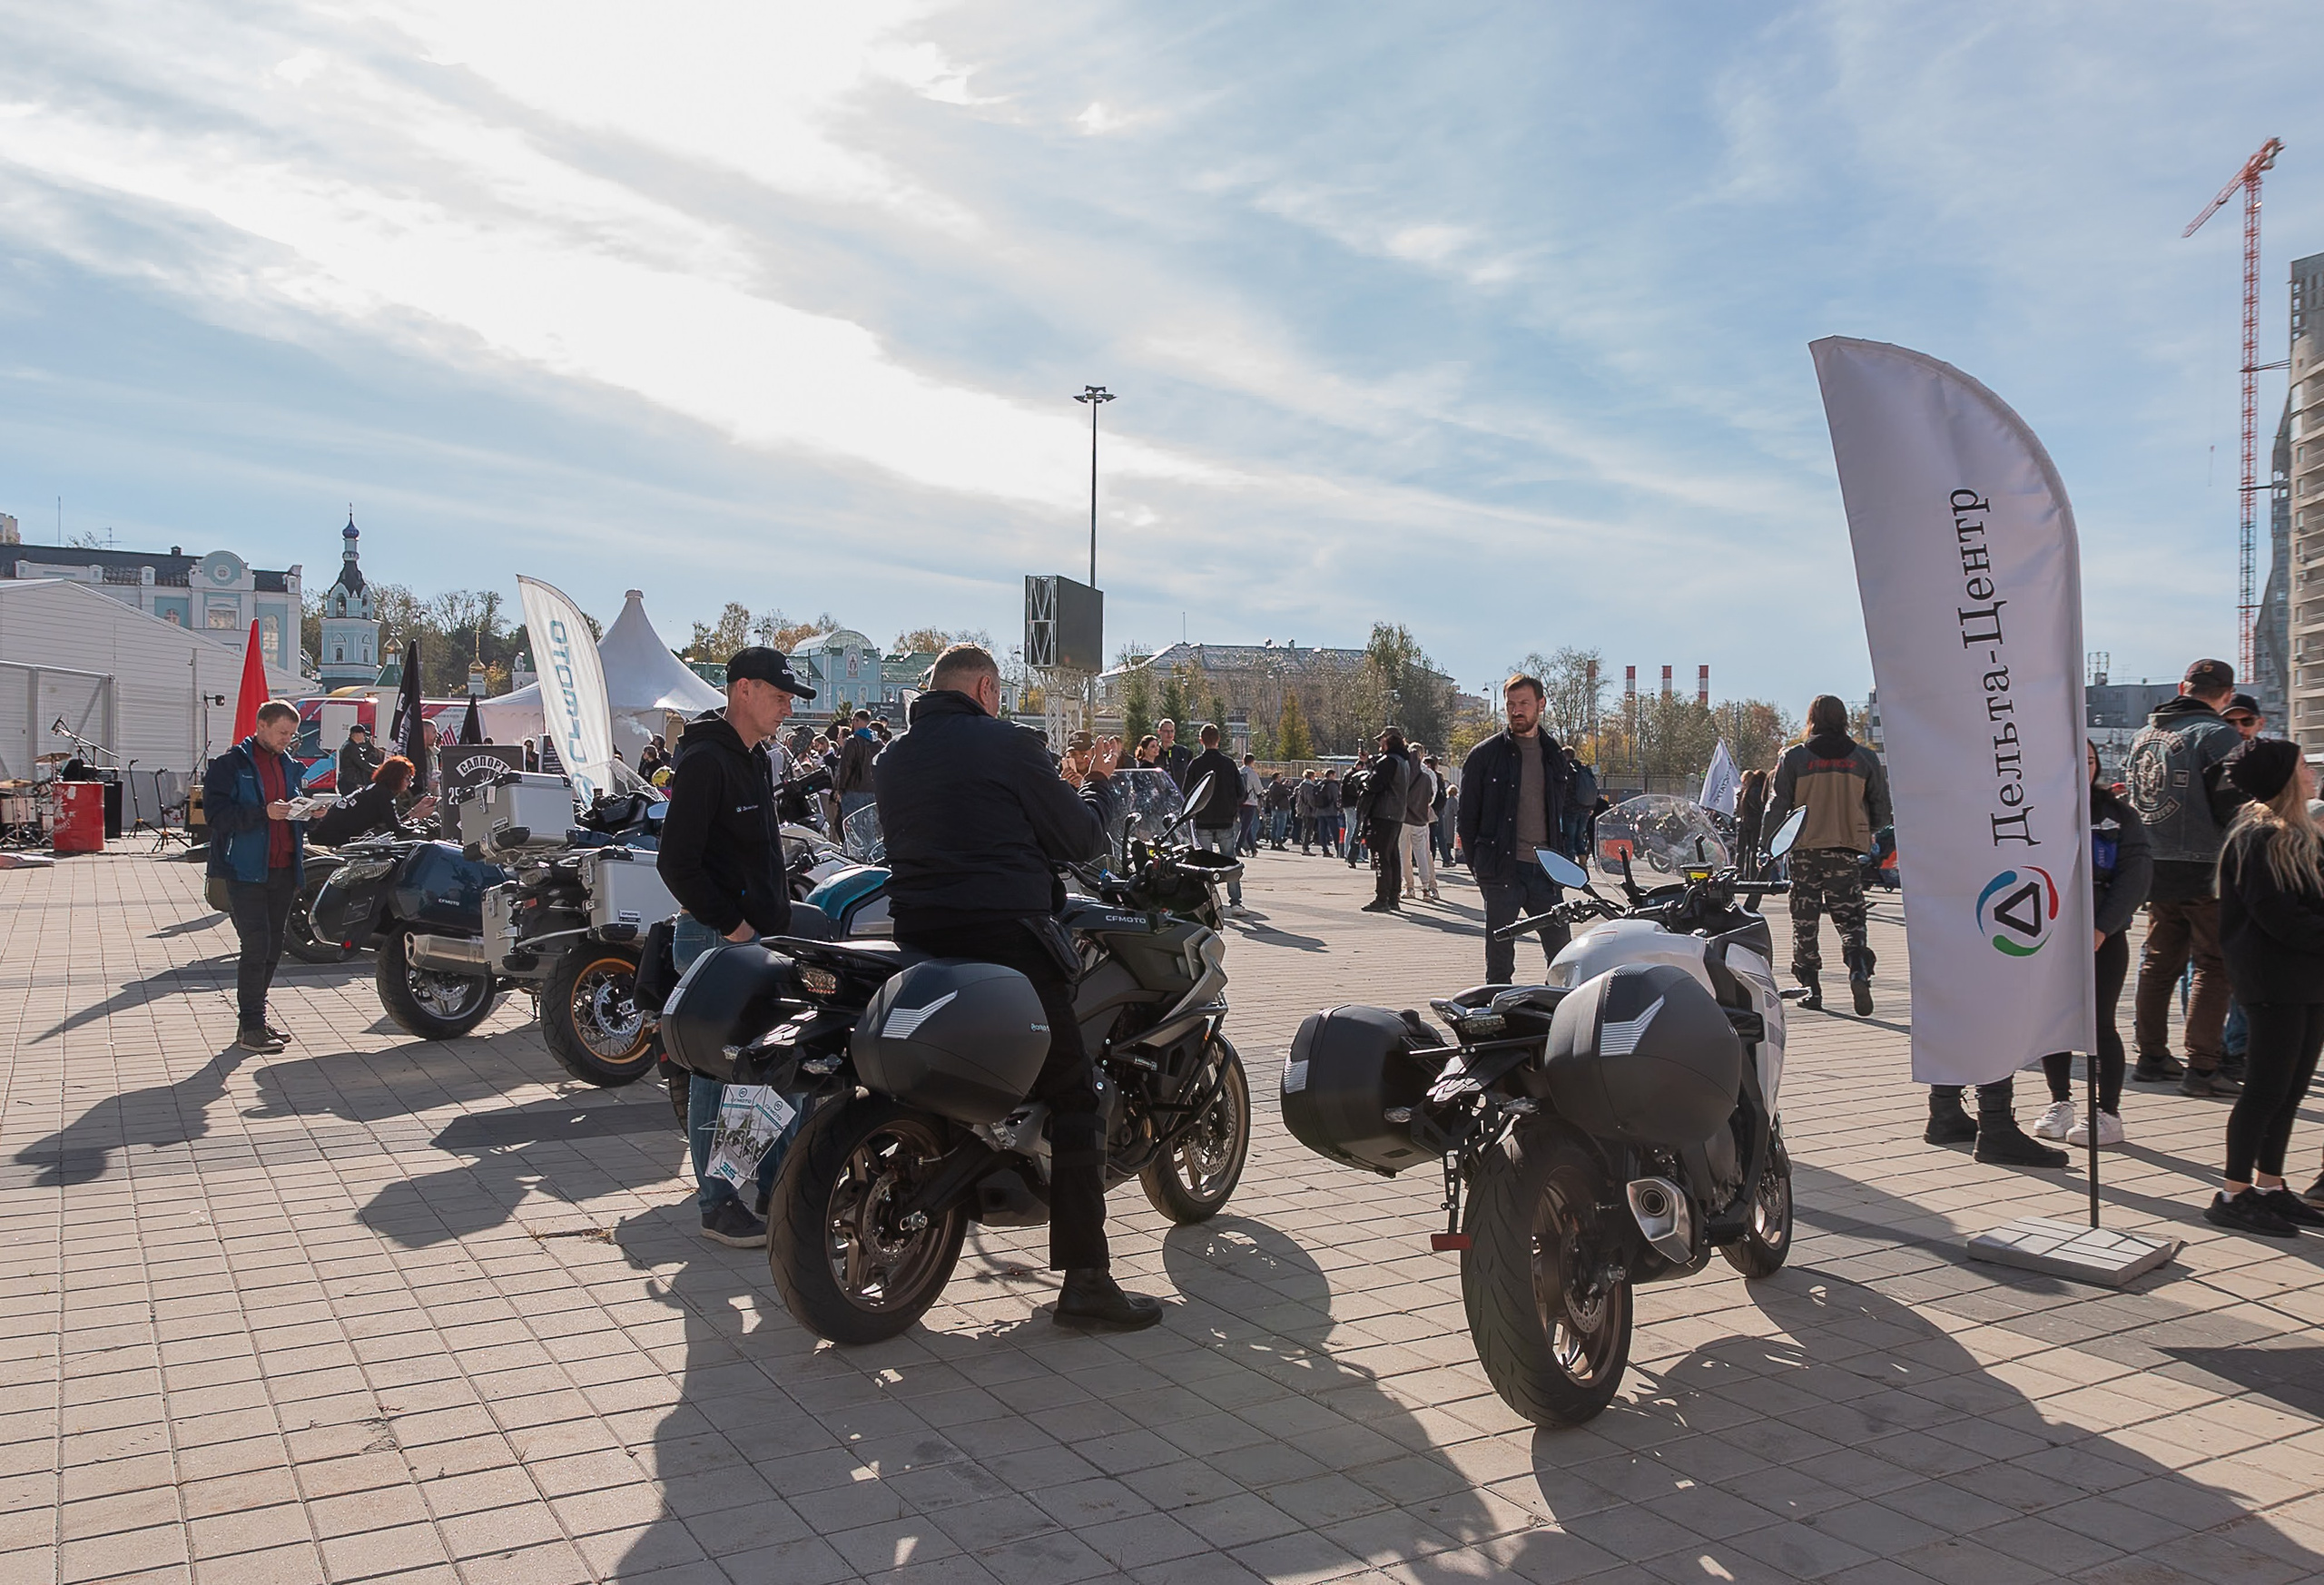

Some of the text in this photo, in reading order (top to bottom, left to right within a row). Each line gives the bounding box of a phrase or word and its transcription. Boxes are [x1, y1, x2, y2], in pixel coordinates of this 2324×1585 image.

[1949, 487, 2042, 848] Дельта-Центр
[459, 756, 508, 773] САППОРТ
[1105, 915, 1147, 924] CFMOTO
